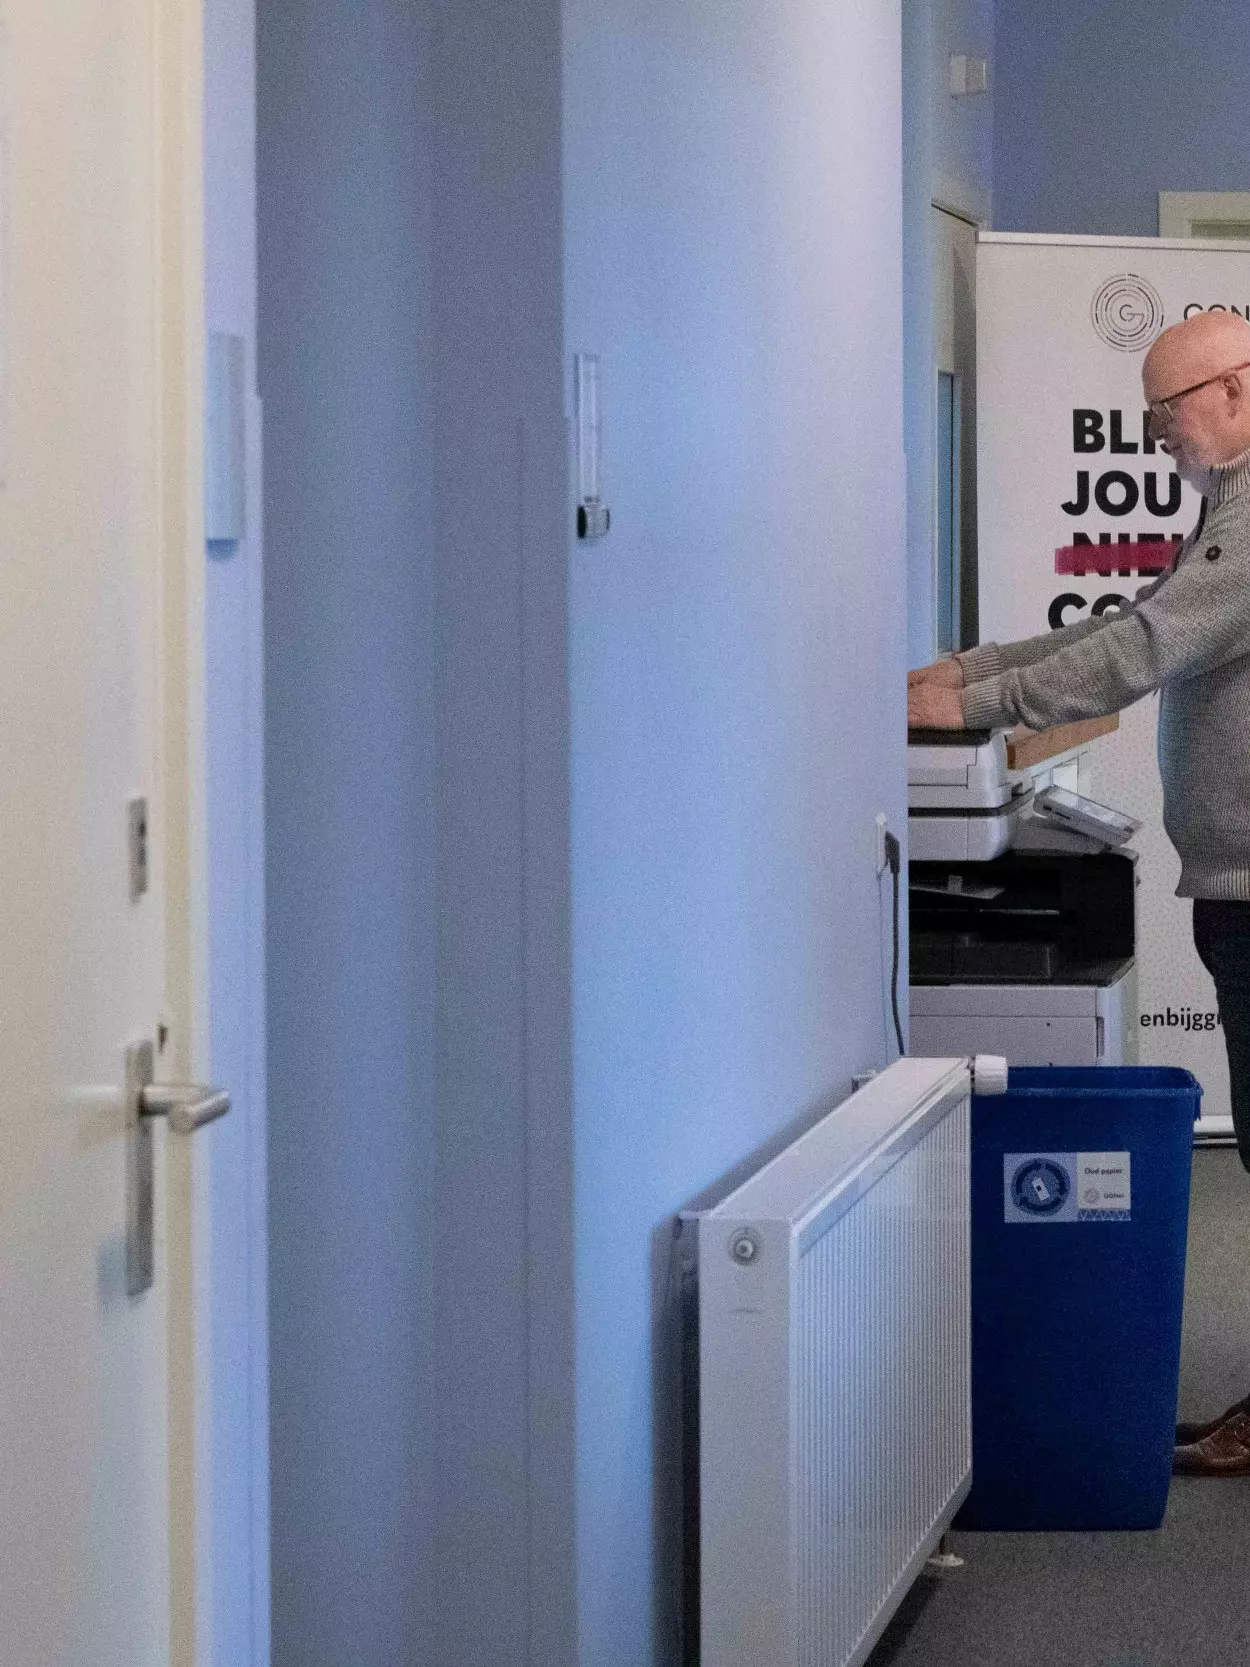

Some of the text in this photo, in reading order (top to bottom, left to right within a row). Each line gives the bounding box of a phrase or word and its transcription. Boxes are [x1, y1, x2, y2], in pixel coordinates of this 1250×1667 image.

[1061, 470, 1182, 517] JOU
[1073, 532, 1184, 577] NIE
[1084, 1167, 1124, 1176] Oud papier
